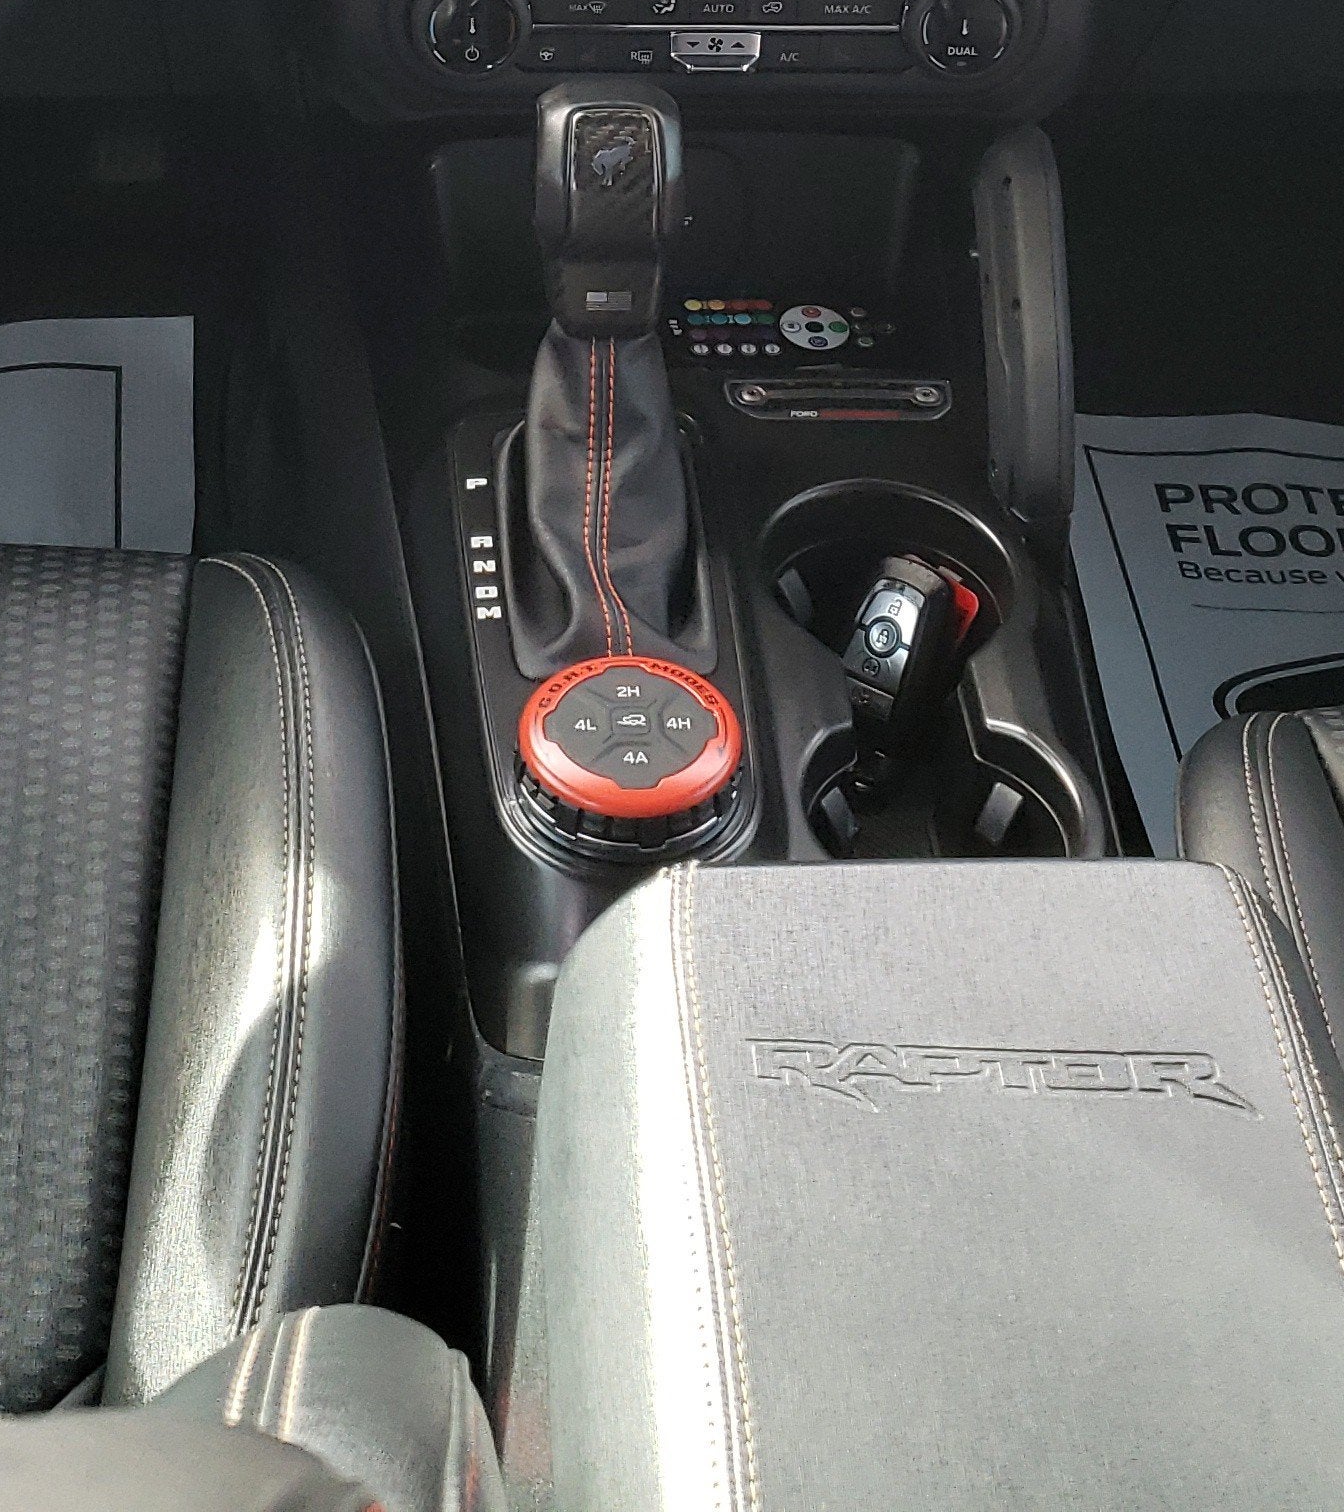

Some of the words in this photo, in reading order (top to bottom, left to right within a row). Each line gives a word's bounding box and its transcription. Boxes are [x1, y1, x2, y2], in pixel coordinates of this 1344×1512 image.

[702, 3, 735, 14] AUTO
[824, 4, 850, 15] MAX
[780, 52, 799, 62] A/C
[947, 46, 978, 56] DUAL
[466, 477, 488, 490] P
[473, 560, 497, 573] N
[1177, 559, 1328, 586] Because
[476, 605, 503, 620] M
[616, 685, 641, 698] 2H
[574, 718, 597, 732] 4L
[666, 717, 691, 731] 4H
[622, 751, 649, 764] 4A
[744, 1037, 1263, 1120] RAPTOR
